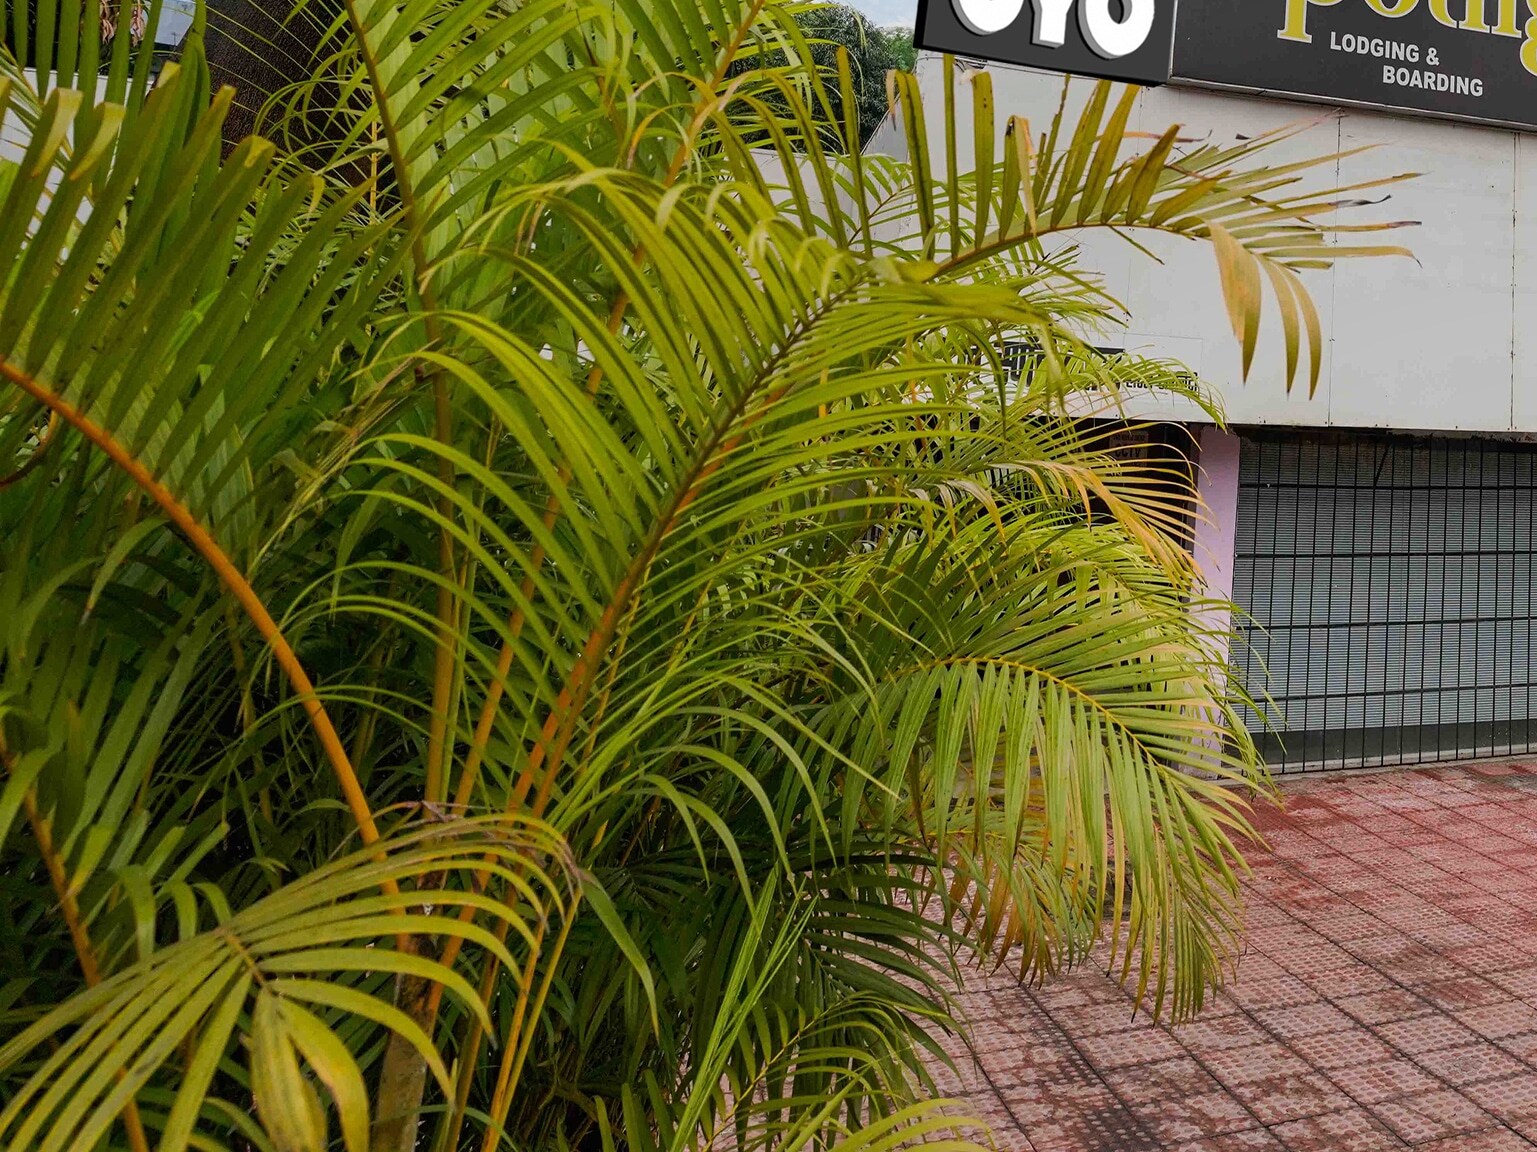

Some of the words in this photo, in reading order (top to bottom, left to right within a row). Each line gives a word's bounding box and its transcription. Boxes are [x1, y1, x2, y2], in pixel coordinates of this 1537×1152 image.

[1330, 31, 1420, 62] LODGING
[1426, 48, 1440, 66] &
[1382, 64, 1483, 97] BOARDING
